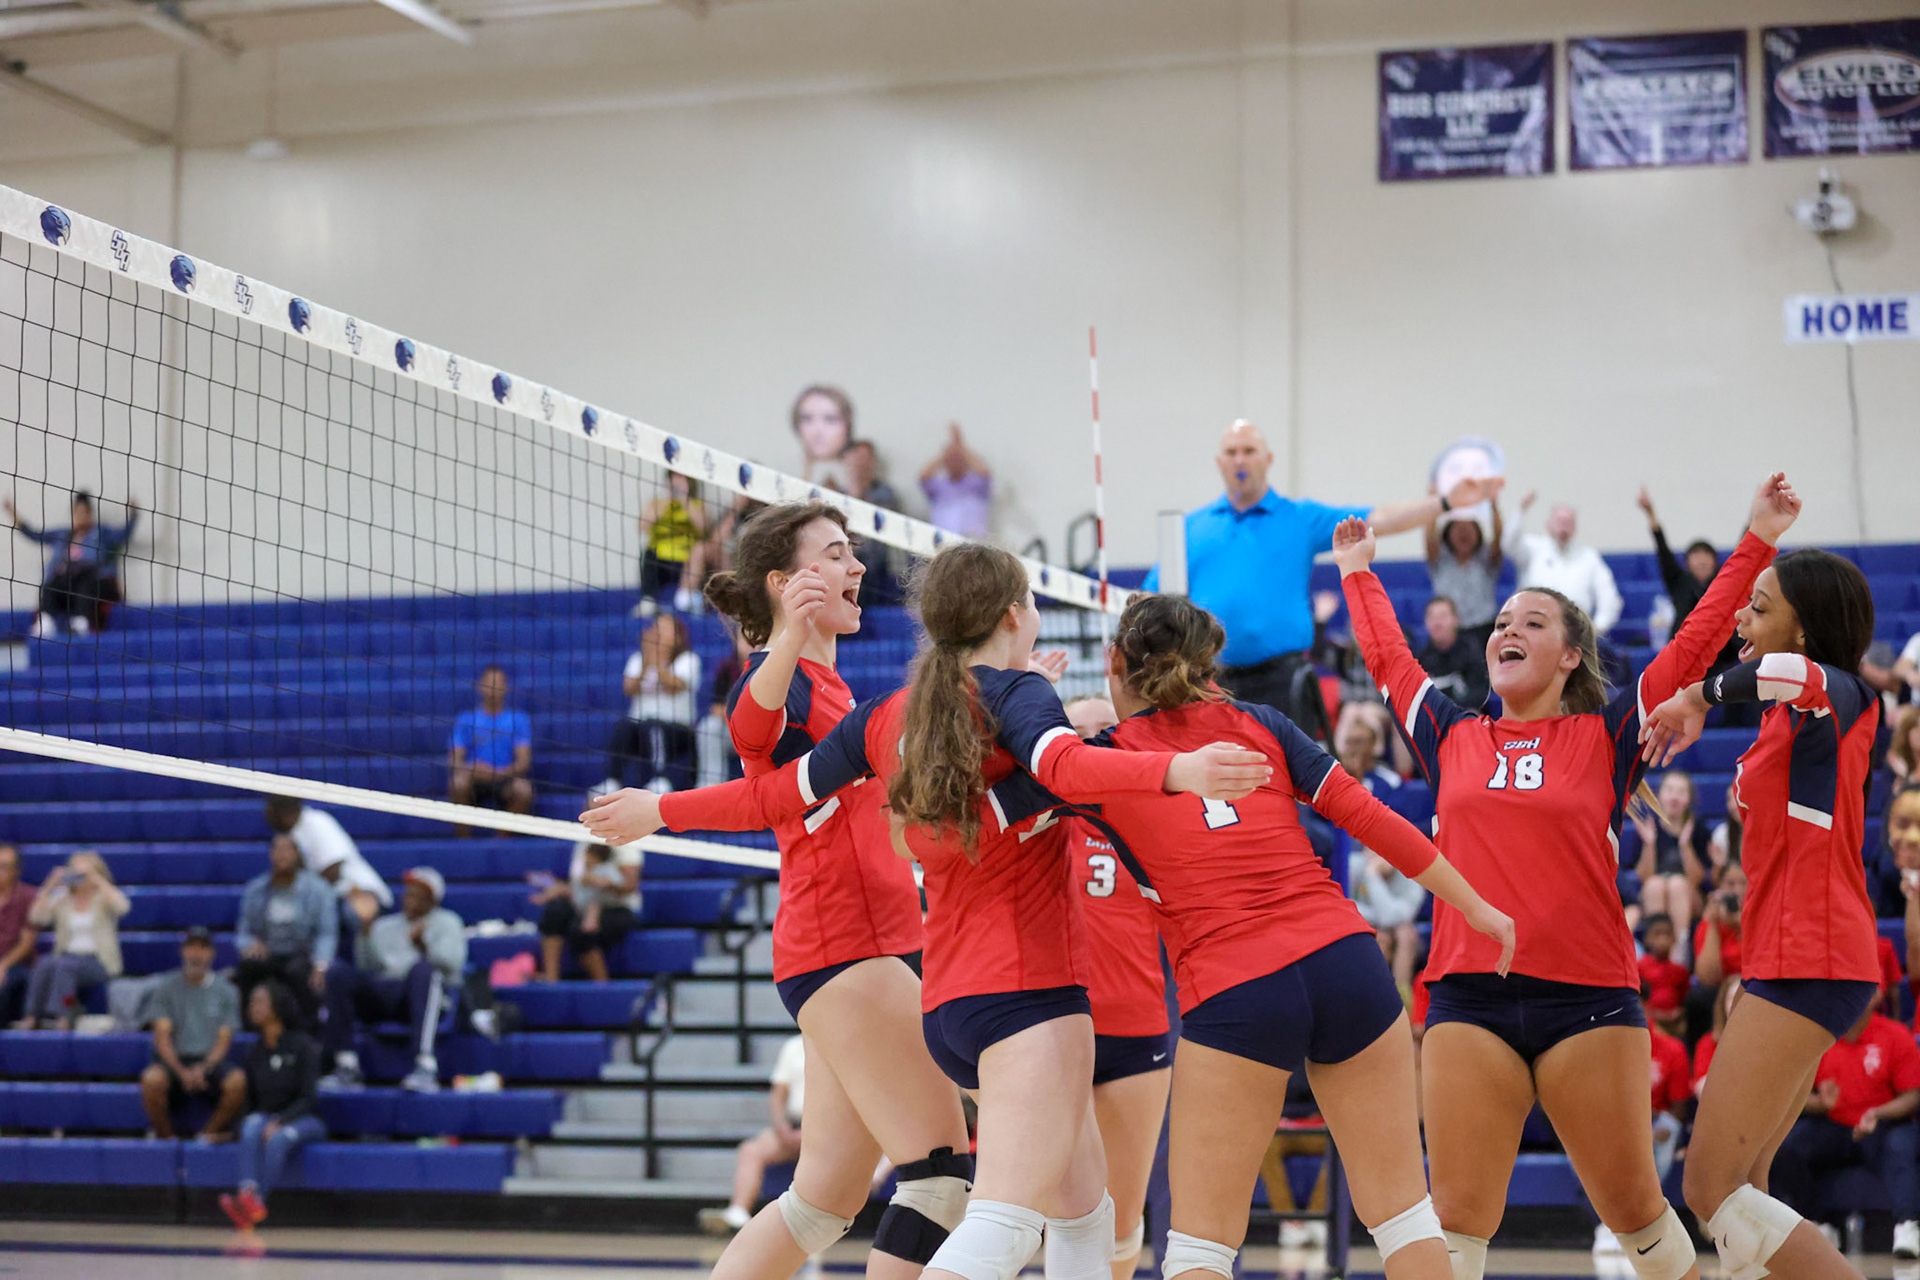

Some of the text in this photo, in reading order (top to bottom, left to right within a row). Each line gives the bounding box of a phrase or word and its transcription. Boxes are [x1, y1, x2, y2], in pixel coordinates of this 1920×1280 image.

[1798, 63, 1916, 82] ELVIS'S
[1802, 301, 1908, 334] HOME
[1486, 750, 1544, 791] 18
[1086, 854, 1117, 898] 3
